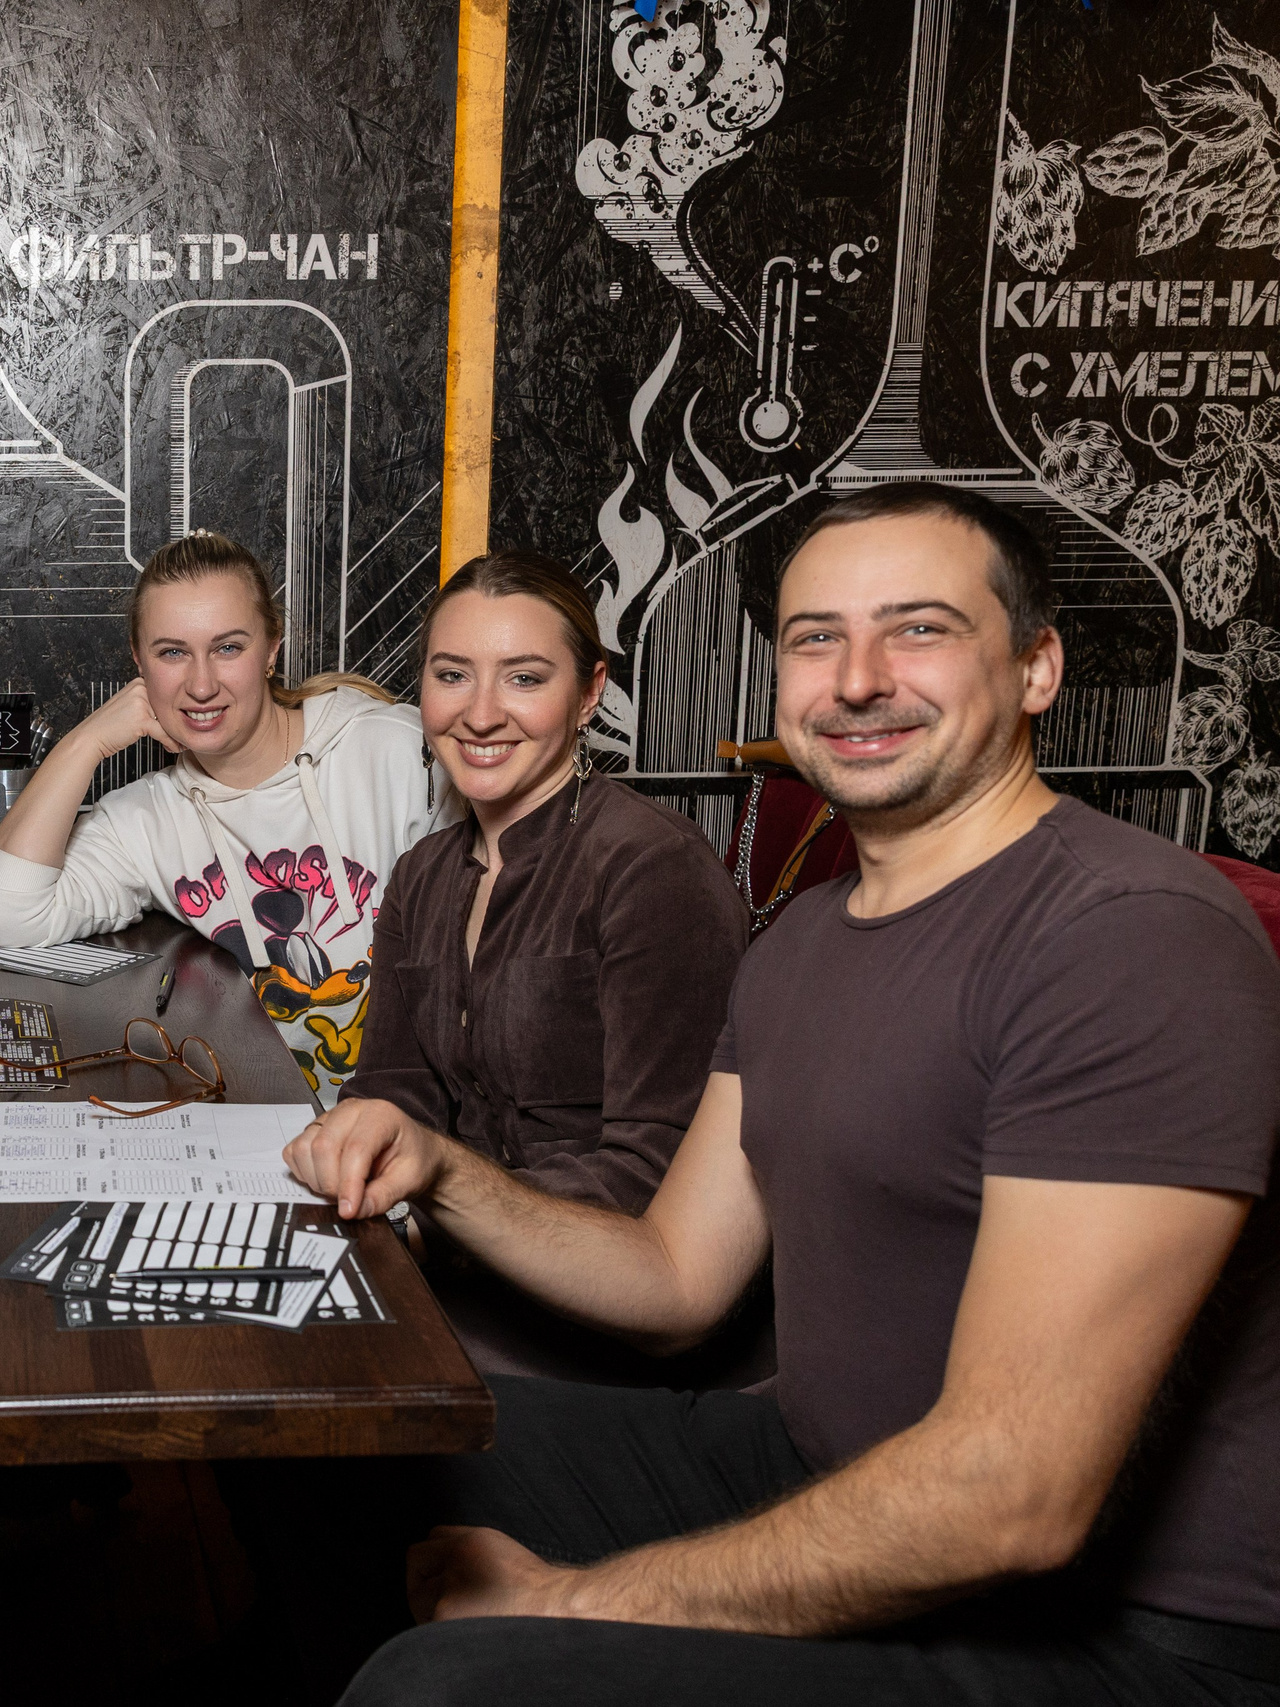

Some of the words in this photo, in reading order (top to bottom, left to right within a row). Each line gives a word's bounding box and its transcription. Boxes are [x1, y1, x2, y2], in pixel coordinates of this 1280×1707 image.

[9, 226, 379, 288] ФИЛЬТР-ЧАН
[993, 280, 1280, 328] КИПЯЧЕНИ
[1010, 352, 1050, 398] С
[63, 1261, 97, 1291] 100
[135, 1290, 153, 1299] 2
[159, 1292, 177, 1302] 3
[184, 1294, 202, 1304] 4
[209, 1296, 228, 1306] 5
[235, 1300, 254, 1309] 6
[137, 1313, 155, 1322] 2
[163, 1313, 180, 1322] 3
